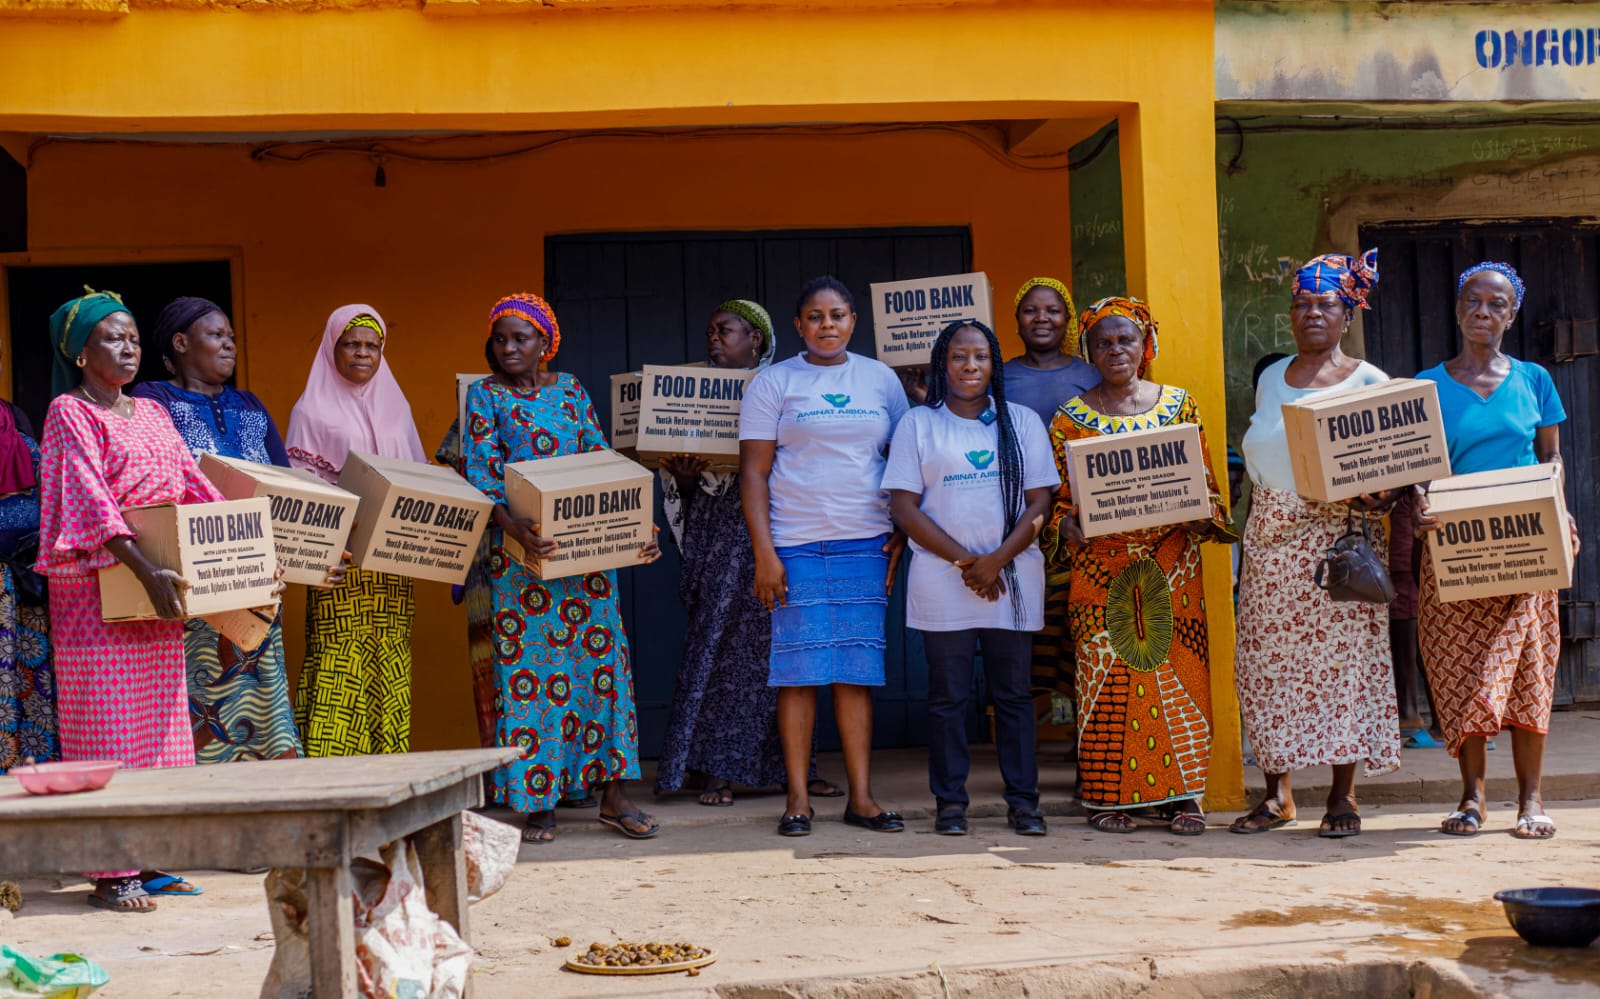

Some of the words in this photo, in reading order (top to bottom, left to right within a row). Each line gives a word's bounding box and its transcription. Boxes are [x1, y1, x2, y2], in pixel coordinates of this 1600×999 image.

[884, 289, 926, 314] FOOD
[930, 284, 974, 310] BANK
[620, 381, 642, 403] FOO
[653, 375, 696, 398] FOOD
[700, 377, 745, 400] BANK
[797, 408, 834, 418] AMINAT
[1328, 409, 1375, 442] FOOD
[1377, 397, 1428, 431] BANK
[1086, 449, 1134, 478] FOOD
[1136, 440, 1188, 471] BANK
[944, 472, 978, 482] AMINAT
[267, 494, 303, 522] OOD
[302, 501, 345, 530] BANK
[390, 496, 435, 524] FOOD
[433, 504, 479, 532] BANK
[553, 494, 594, 521] FOOD
[599, 487, 642, 515] BANK
[189, 516, 224, 545] FOOD
[226, 512, 263, 541] BANK
[1436, 519, 1486, 546] FOOD
[1489, 512, 1544, 540] BANK
